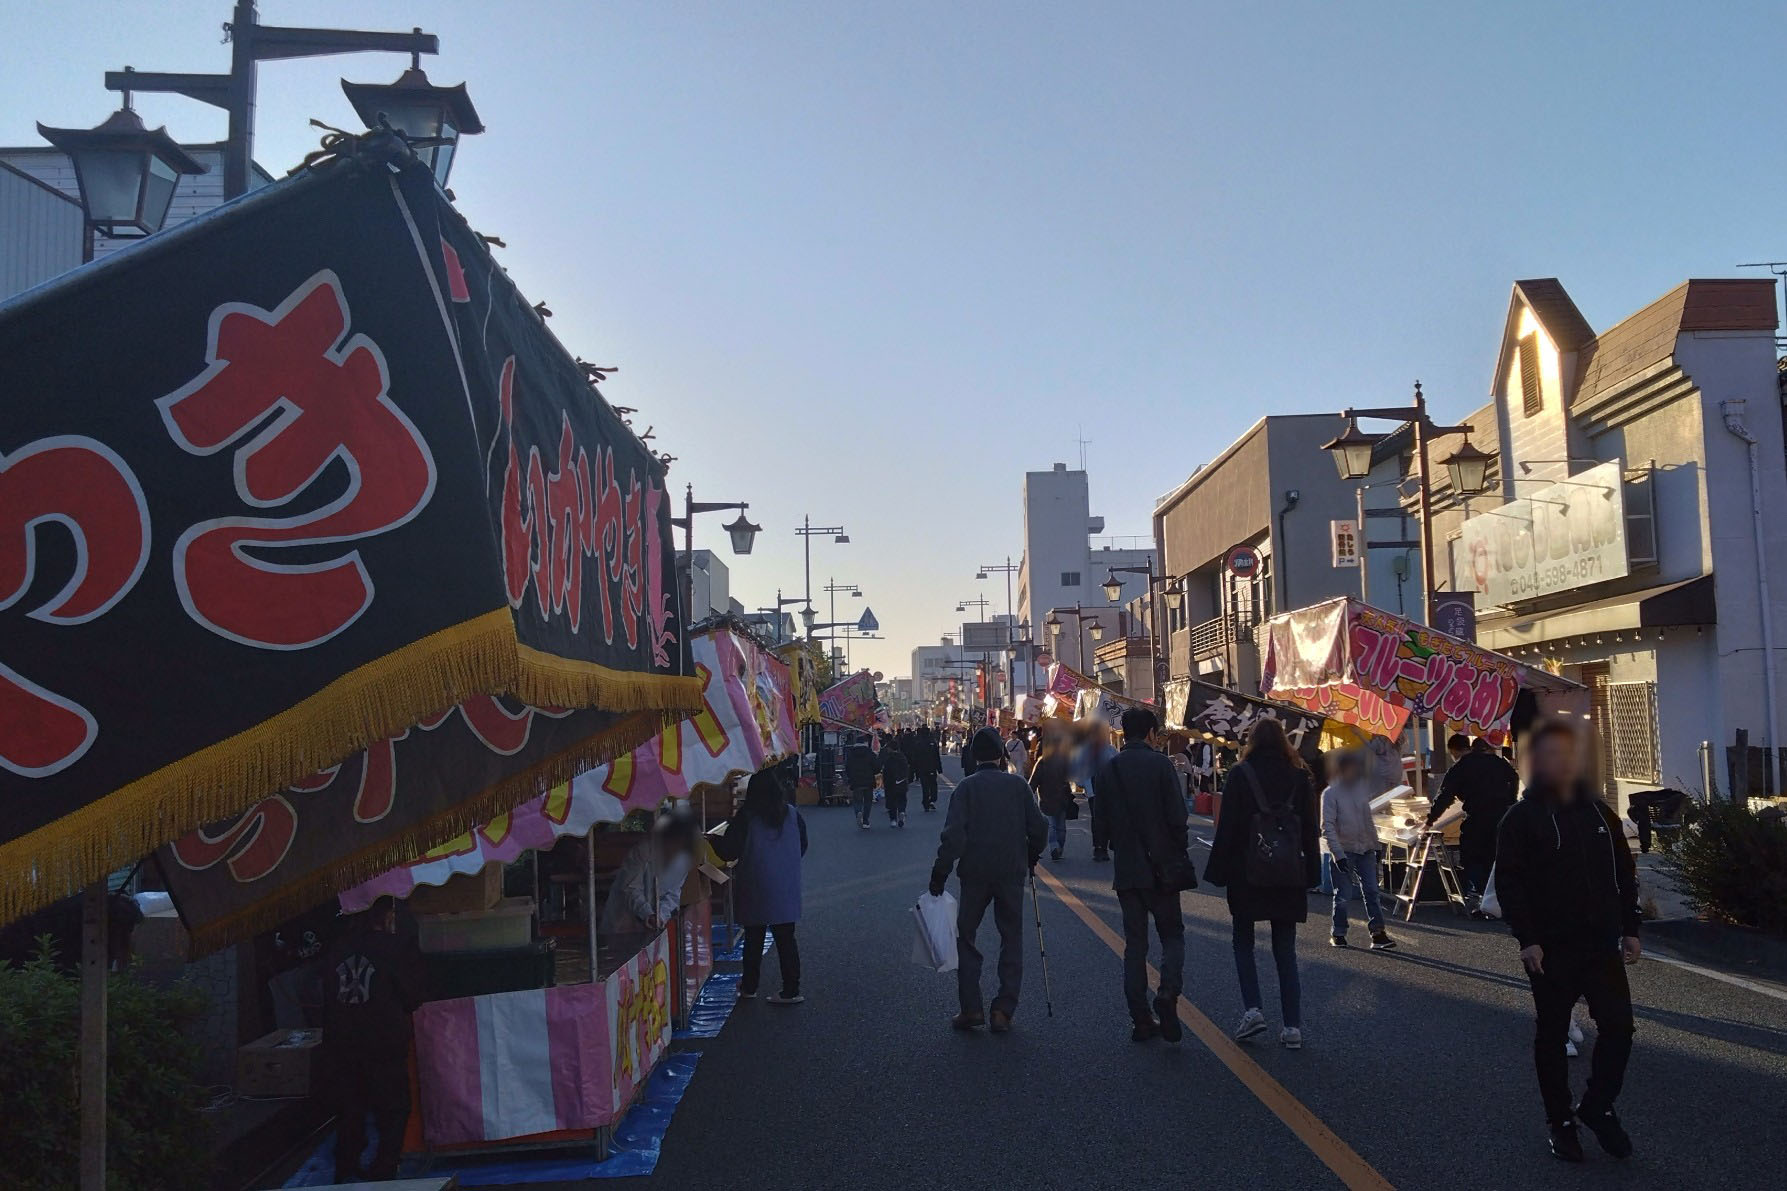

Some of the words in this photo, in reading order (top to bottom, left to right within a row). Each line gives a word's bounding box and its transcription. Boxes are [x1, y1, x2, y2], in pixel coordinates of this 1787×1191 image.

[499, 354, 644, 650] いかやき
[1355, 625, 1501, 730] フルーツあめ
